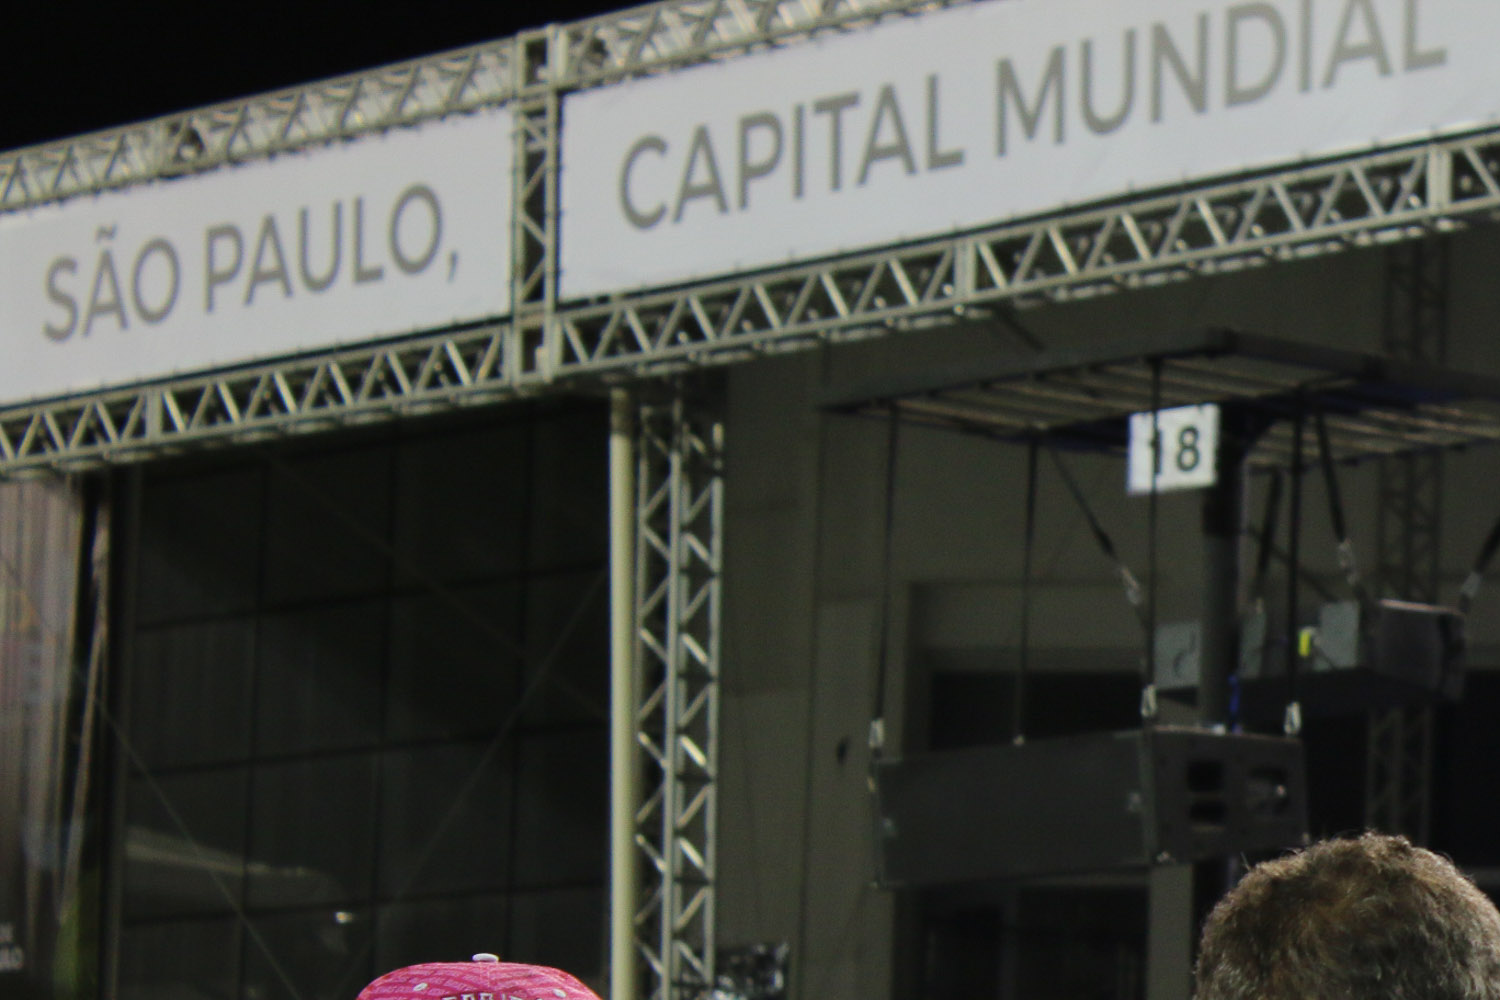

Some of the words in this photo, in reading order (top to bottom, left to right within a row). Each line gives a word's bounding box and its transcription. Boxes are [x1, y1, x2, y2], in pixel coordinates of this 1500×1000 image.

[617, 73, 966, 231] CAPITAL
[994, 0, 1449, 158] MUNDIAL
[43, 224, 182, 343] SÃO
[204, 184, 460, 313] PAULO,
